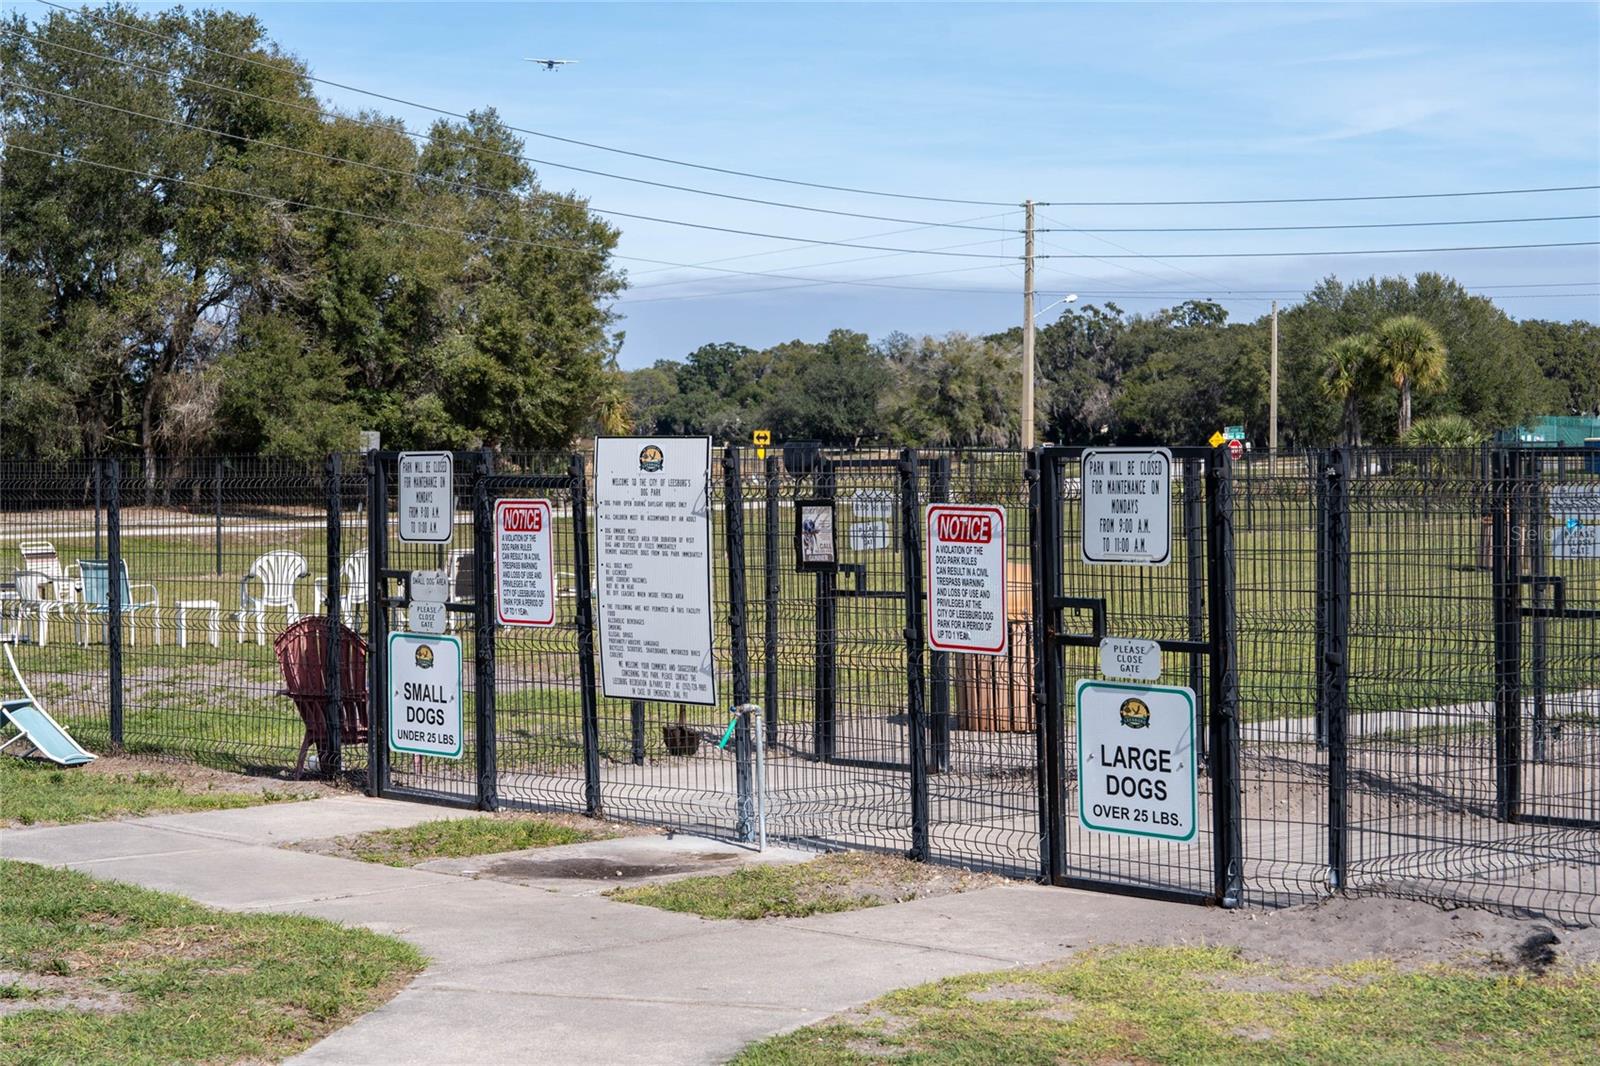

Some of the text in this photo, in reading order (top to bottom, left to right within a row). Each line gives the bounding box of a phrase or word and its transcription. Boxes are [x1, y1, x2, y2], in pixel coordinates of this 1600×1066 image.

[403, 461, 447, 473] PARK WILL BE CLOSED
[1090, 461, 1162, 475] PARK WILL BE CLOSED
[414, 477, 438, 487] MAINTENANCE
[440, 477, 445, 487] ON
[1092, 480, 1159, 494] FOR MAINTENANCE ON
[416, 492, 432, 502] MONDAYS
[1111, 500, 1138, 513] MONDAYS
[409, 507, 418, 518] FROM
[504, 510, 540, 529] NOTICE
[411, 522, 415, 533] TO
[940, 517, 989, 540] NOTICE
[1100, 519, 1151, 532] FROM 9:00 A.M.
[941, 546, 965, 554] VIOLATION
[966, 546, 972, 554] OF
[974, 546, 983, 554] THE
[1103, 538, 1147, 552] TO 11:00 A.M.
[936, 556, 977, 565] DOG PARK RULES
[936, 567, 946, 575] CAN
[947, 567, 965, 575] RESULT
[966, 568, 971, 576] IN
[977, 568, 988, 576] CIVIL
[413, 577, 424, 585] SMALL
[937, 577, 984, 587] TRESPASS WARNING
[937, 588, 990, 598] AND LOSS OF USE AND
[937, 599, 981, 608] PRIVILEGES AT THE
[937, 609, 993, 620] CITY OF LEESBURG DOG
[937, 620, 950, 628] PARK
[951, 620, 961, 629] FOR
[967, 621, 984, 630] PERIOD
[985, 622, 992, 630] OF
[938, 630, 944, 638] UP
[1114, 645, 1145, 654] PLEASE
[1117, 655, 1143, 663] CLOSE
[404, 682, 447, 704] SMALL
[407, 706, 444, 726] DOGS
[398, 730, 456, 745] UNDER 25 LBS.
[1101, 744, 1172, 772] LARGE
[1106, 775, 1167, 799] DOGS
[1093, 804, 1182, 826] OVER 25 LBS.
